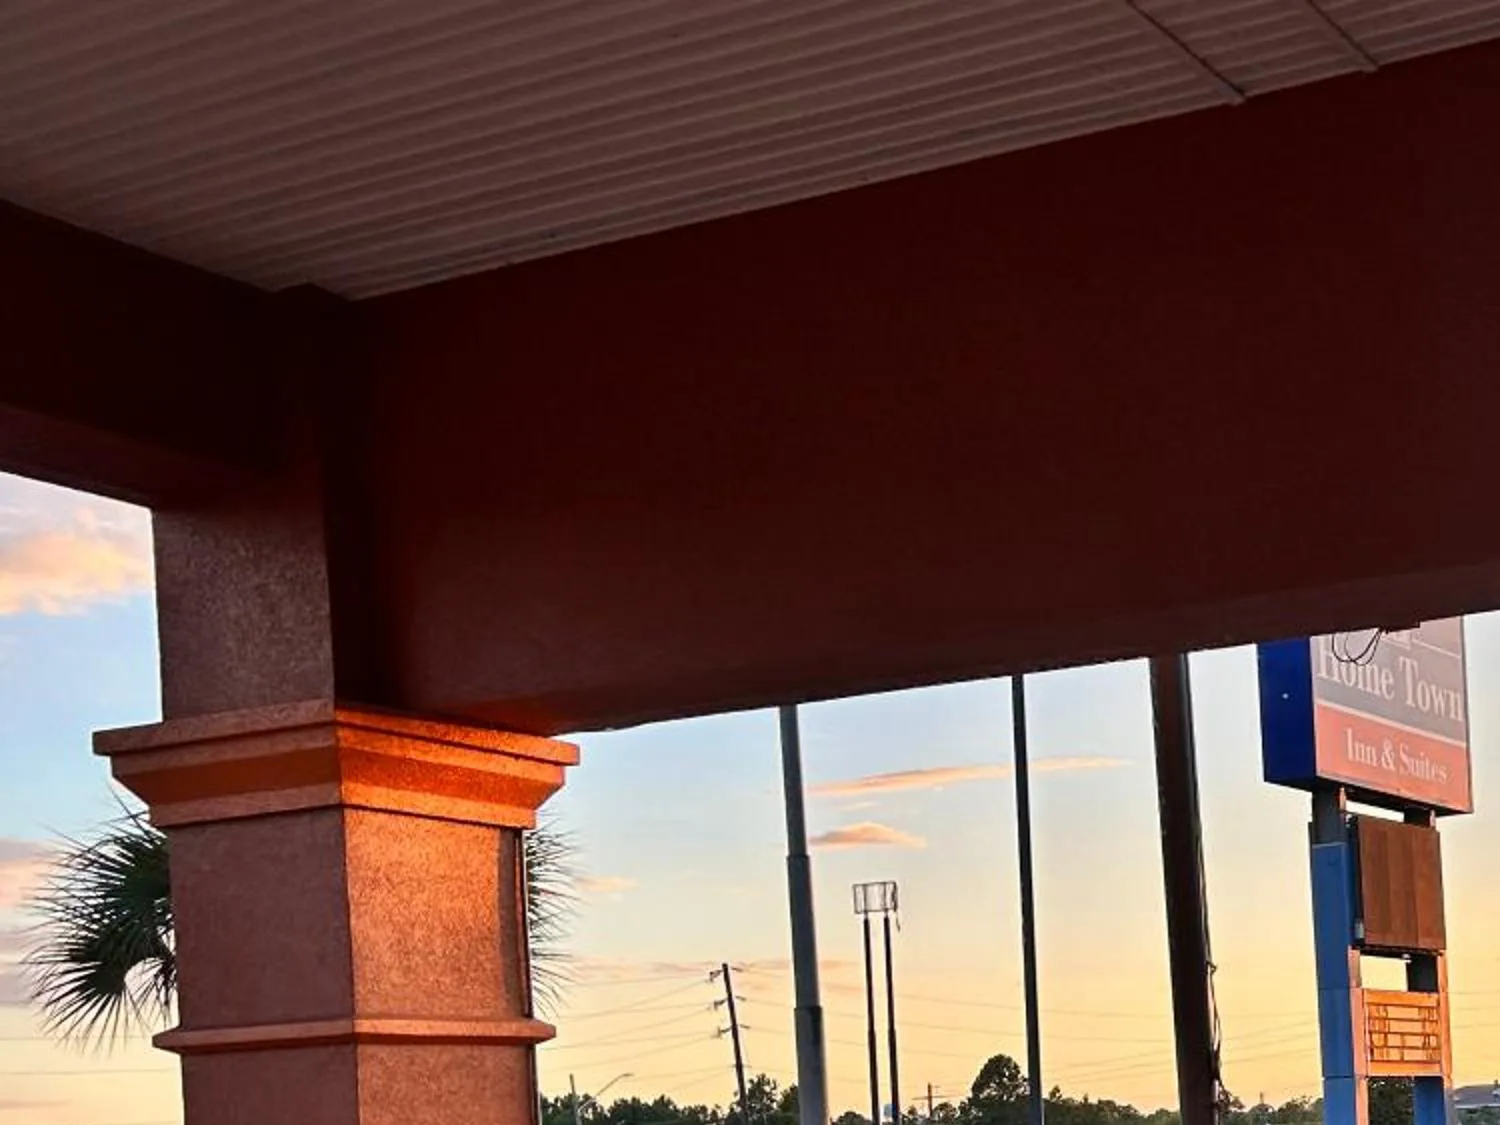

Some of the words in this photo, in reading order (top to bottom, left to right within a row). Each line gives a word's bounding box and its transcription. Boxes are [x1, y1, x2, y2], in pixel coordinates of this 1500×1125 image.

[1318, 637, 1395, 700] Home
[1399, 656, 1463, 721] Town
[1346, 728, 1378, 768] Inn
[1381, 738, 1396, 772] &
[1400, 743, 1448, 784] Suites
